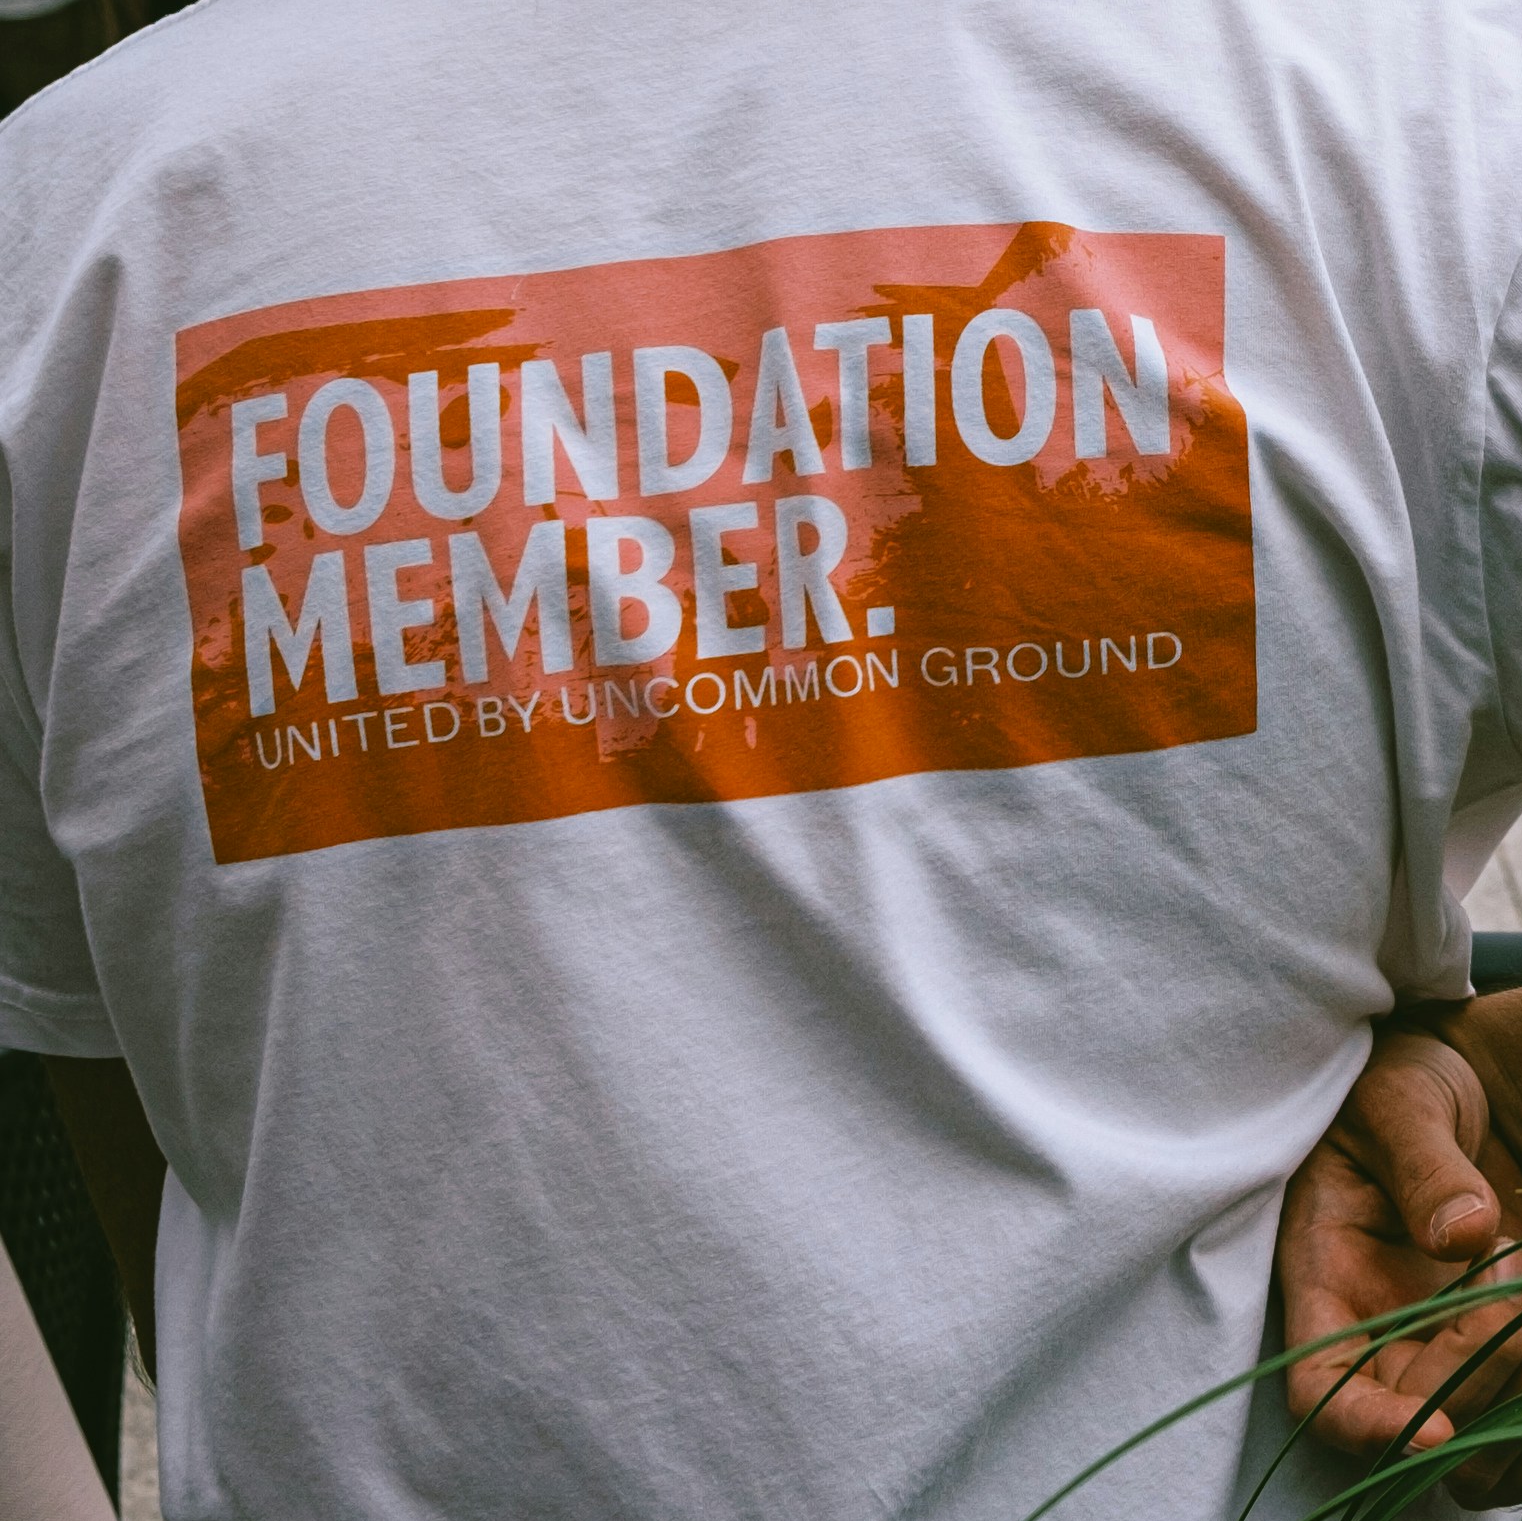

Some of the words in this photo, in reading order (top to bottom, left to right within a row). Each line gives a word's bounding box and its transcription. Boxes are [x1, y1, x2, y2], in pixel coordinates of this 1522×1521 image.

[232, 308, 1170, 551] FOUNDATION
[241, 494, 896, 718] MEMBER.
[256, 701, 461, 771] UNITED
[476, 691, 543, 737] BY
[561, 649, 900, 726] UNCOMMON
[920, 631, 1183, 687] GROUND
